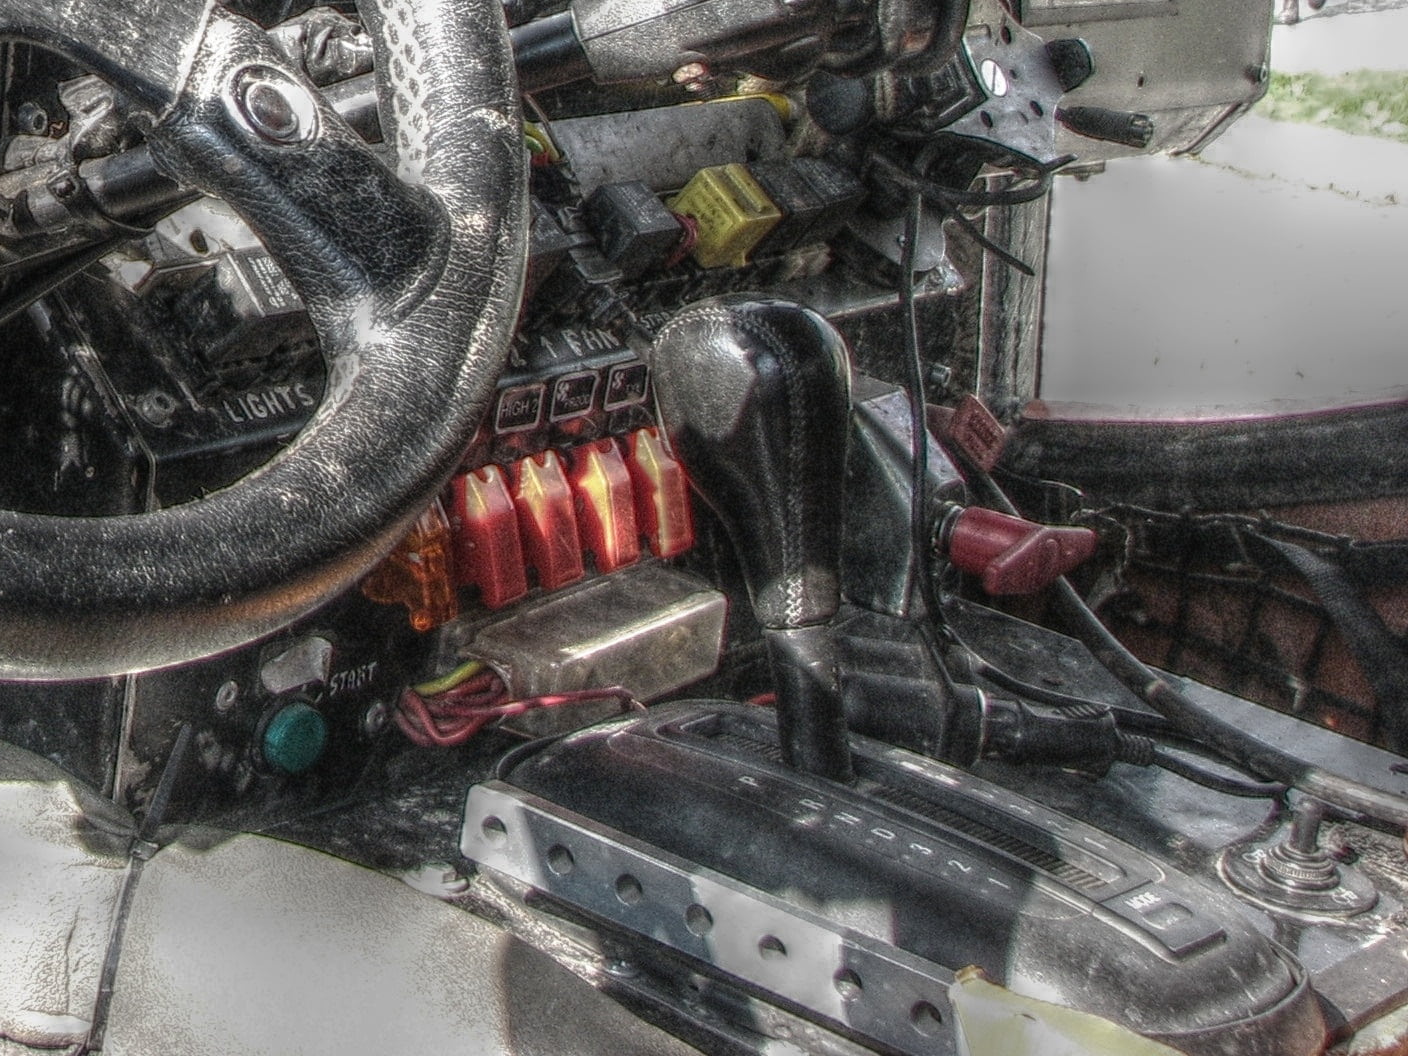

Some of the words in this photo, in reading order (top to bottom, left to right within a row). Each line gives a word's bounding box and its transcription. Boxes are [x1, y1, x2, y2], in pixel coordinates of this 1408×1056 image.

[223, 382, 314, 423] LIGHTS
[501, 399, 530, 419] HIGH
[330, 661, 378, 697] START
[738, 775, 759, 788] P
[798, 798, 825, 811] R
[871, 827, 896, 840] D
[909, 843, 933, 855] 3
[947, 859, 972, 873] 2
